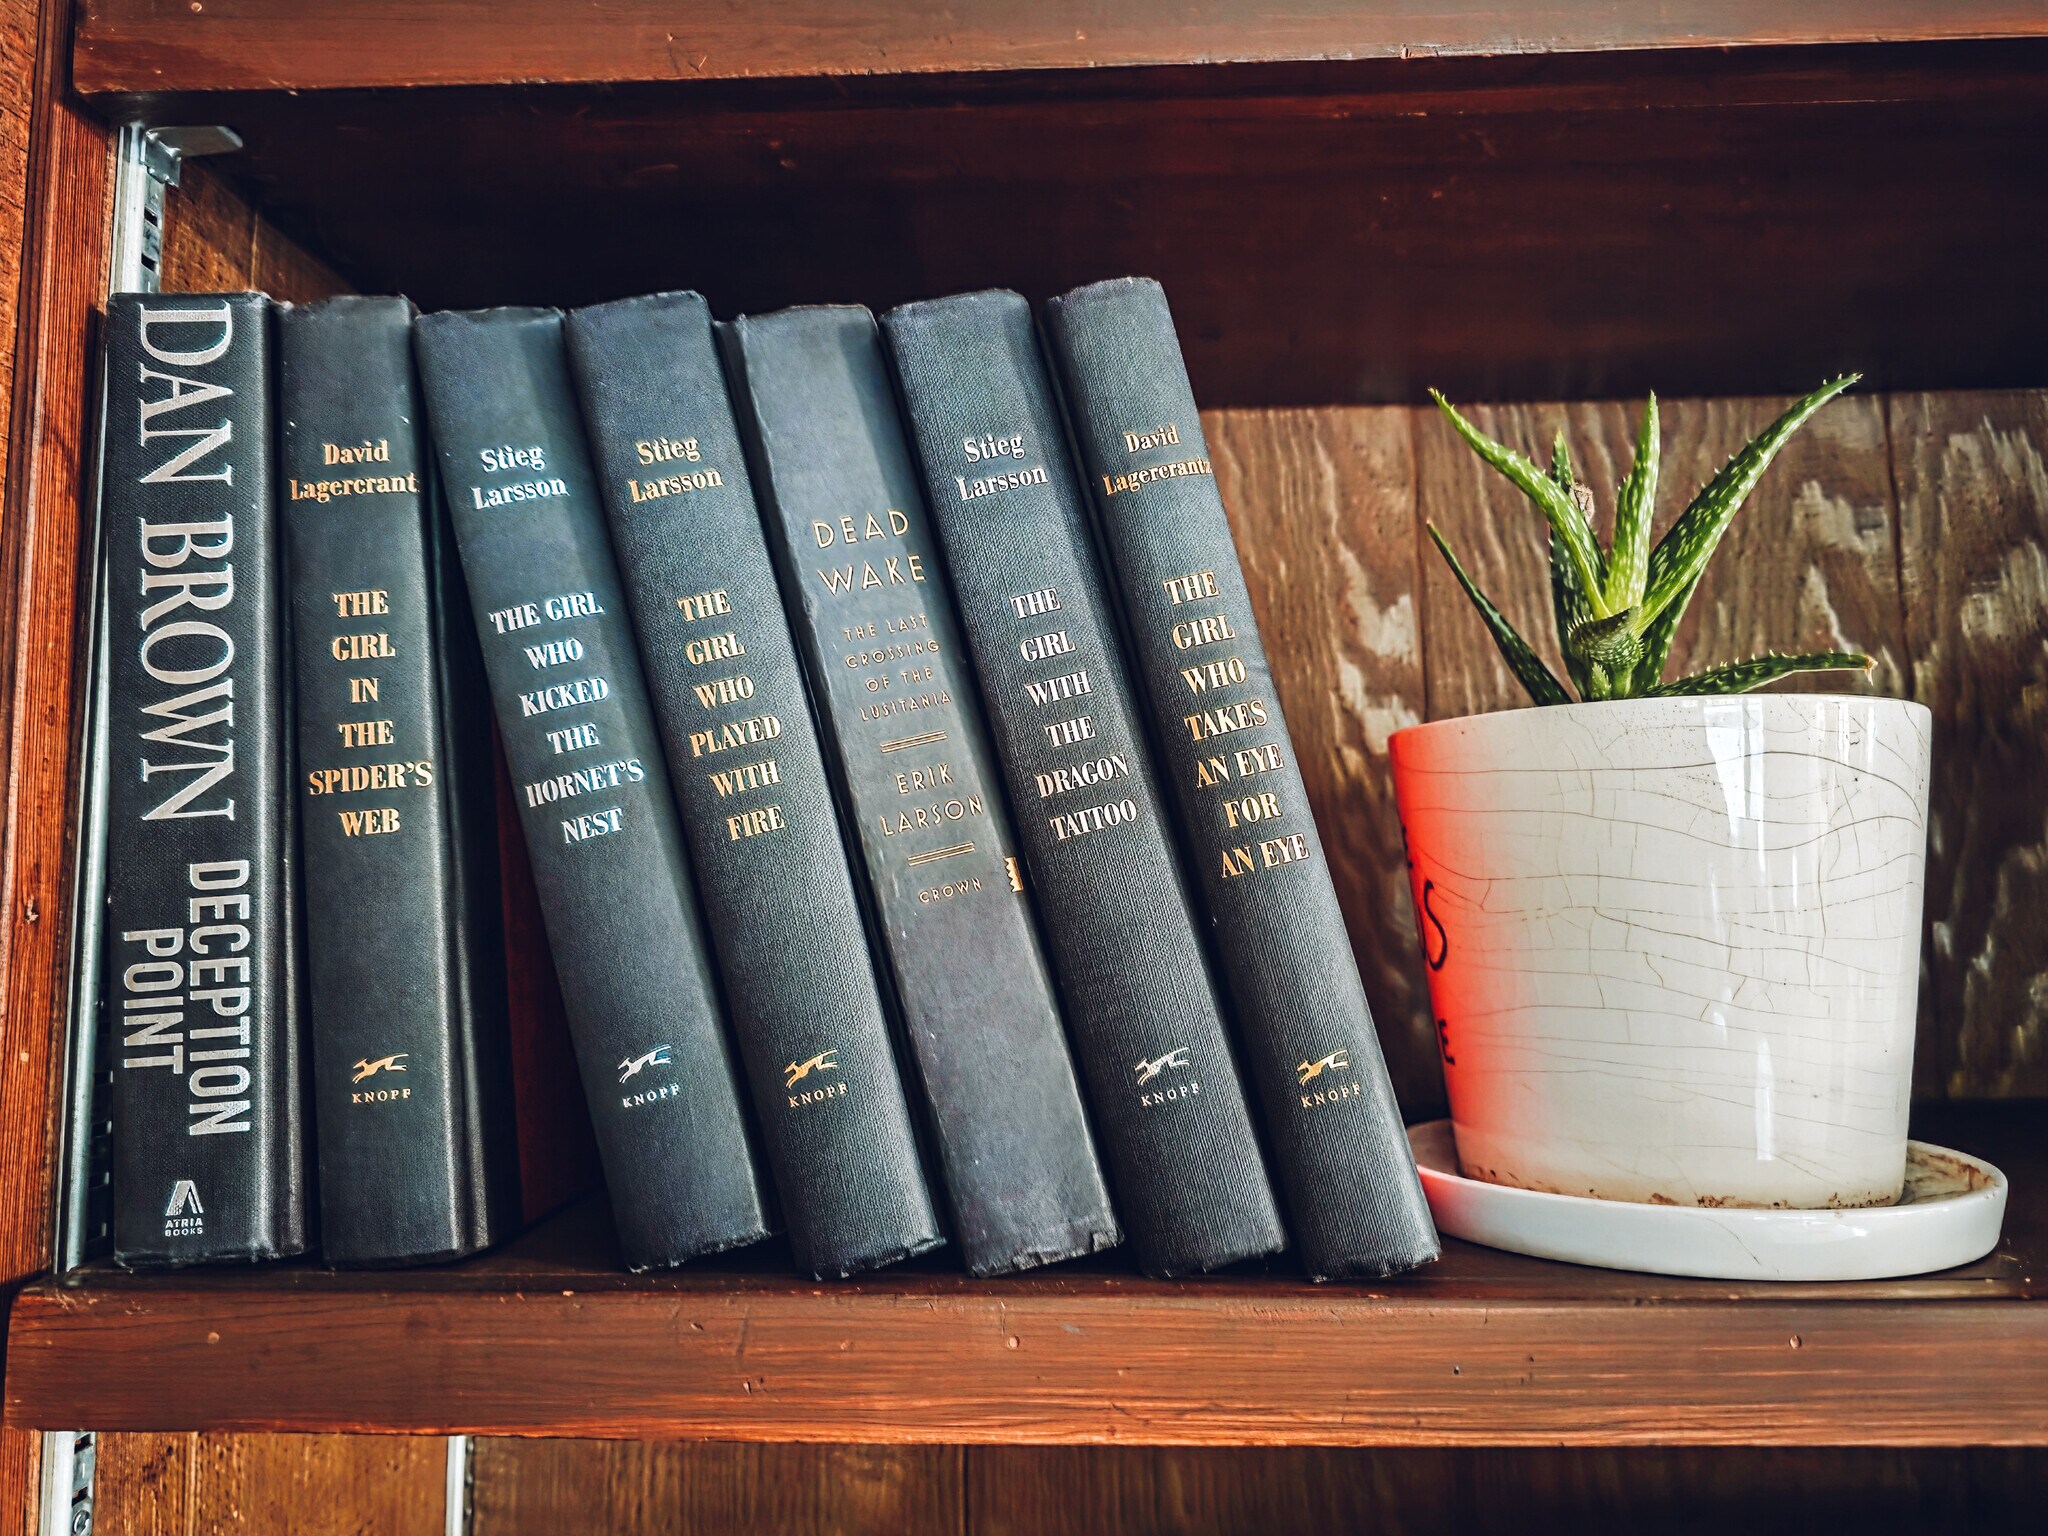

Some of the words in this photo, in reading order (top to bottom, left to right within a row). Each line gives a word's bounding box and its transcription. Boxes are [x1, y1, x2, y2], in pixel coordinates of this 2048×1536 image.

[140, 303, 234, 486] DAN
[323, 439, 390, 465] David
[637, 437, 701, 466] Stieg
[963, 434, 1025, 463] Stieg
[1125, 426, 1179, 453] David
[480, 446, 546, 472] Stieg
[290, 473, 417, 502] Lagercrant
[471, 477, 568, 510] Larsson
[627, 469, 723, 502] Larsson
[956, 466, 1048, 501] Larsson
[812, 509, 909, 548] DEAD
[817, 555, 926, 596] WAKE
[1163, 571, 1220, 605] THE
[333, 591, 389, 617] THE
[489, 602, 540, 634] THE
[545, 592, 604, 622] GIRL
[677, 589, 731, 622] THE
[1010, 588, 1061, 619] THE
[844, 622, 877, 643] THE
[887, 614, 928, 634] LAST
[1171, 614, 1235, 650] GIRL
[332, 633, 395, 660] GIRL
[524, 638, 583, 670] WHO
[686, 632, 745, 665] GIRL
[845, 640, 941, 668] CROSSING
[1020, 630, 1077, 662] GIRL
[140, 512, 235, 821] BROWN
[865, 675, 890, 692] OF
[901, 667, 933, 685] THE
[1181, 658, 1247, 695] WHO
[351, 677, 379, 704] IN
[518, 677, 609, 717] KICKED
[693, 676, 754, 710] WHO
[1026, 670, 1092, 707] WITH
[859, 690, 952, 722] LUSITANIA
[1184, 700, 1267, 741] TAKES
[339, 720, 394, 748] THE
[546, 723, 600, 755] THE
[689, 715, 781, 757] PLAYED
[1045, 716, 1096, 748] THE
[308, 762, 433, 795] SPIDER'S
[710, 761, 780, 797] WITH
[894, 764, 954, 794] ERIK
[1035, 754, 1129, 799] DRAGON
[1196, 755, 1232, 789] AN
[1236, 743, 1284, 777] EYE
[525, 758, 644, 808] HORNET'S
[339, 809, 400, 836] WEB
[561, 808, 623, 844] NEST
[726, 805, 785, 841] FIRE
[880, 794, 984, 837] LARSON
[1049, 799, 1137, 841] TATTOO
[1223, 793, 1281, 828] FOR
[1221, 846, 1256, 879] AN
[1259, 833, 1310, 868] EYE
[918, 877, 982, 904] CROWN
[124, 928, 184, 1074] POINT
[189, 860, 251, 1135] DECEPTION
[351, 1089, 412, 1103] KNOPF
[622, 1082, 681, 1108] KNOPF
[788, 1083, 848, 1109] KNOPF
[1141, 1082, 1200, 1107] KNOPF
[1301, 1083, 1361, 1108] KNOPF
[165, 1217, 203, 1228] ATRIA
[165, 1227, 203, 1237] BOOKS
